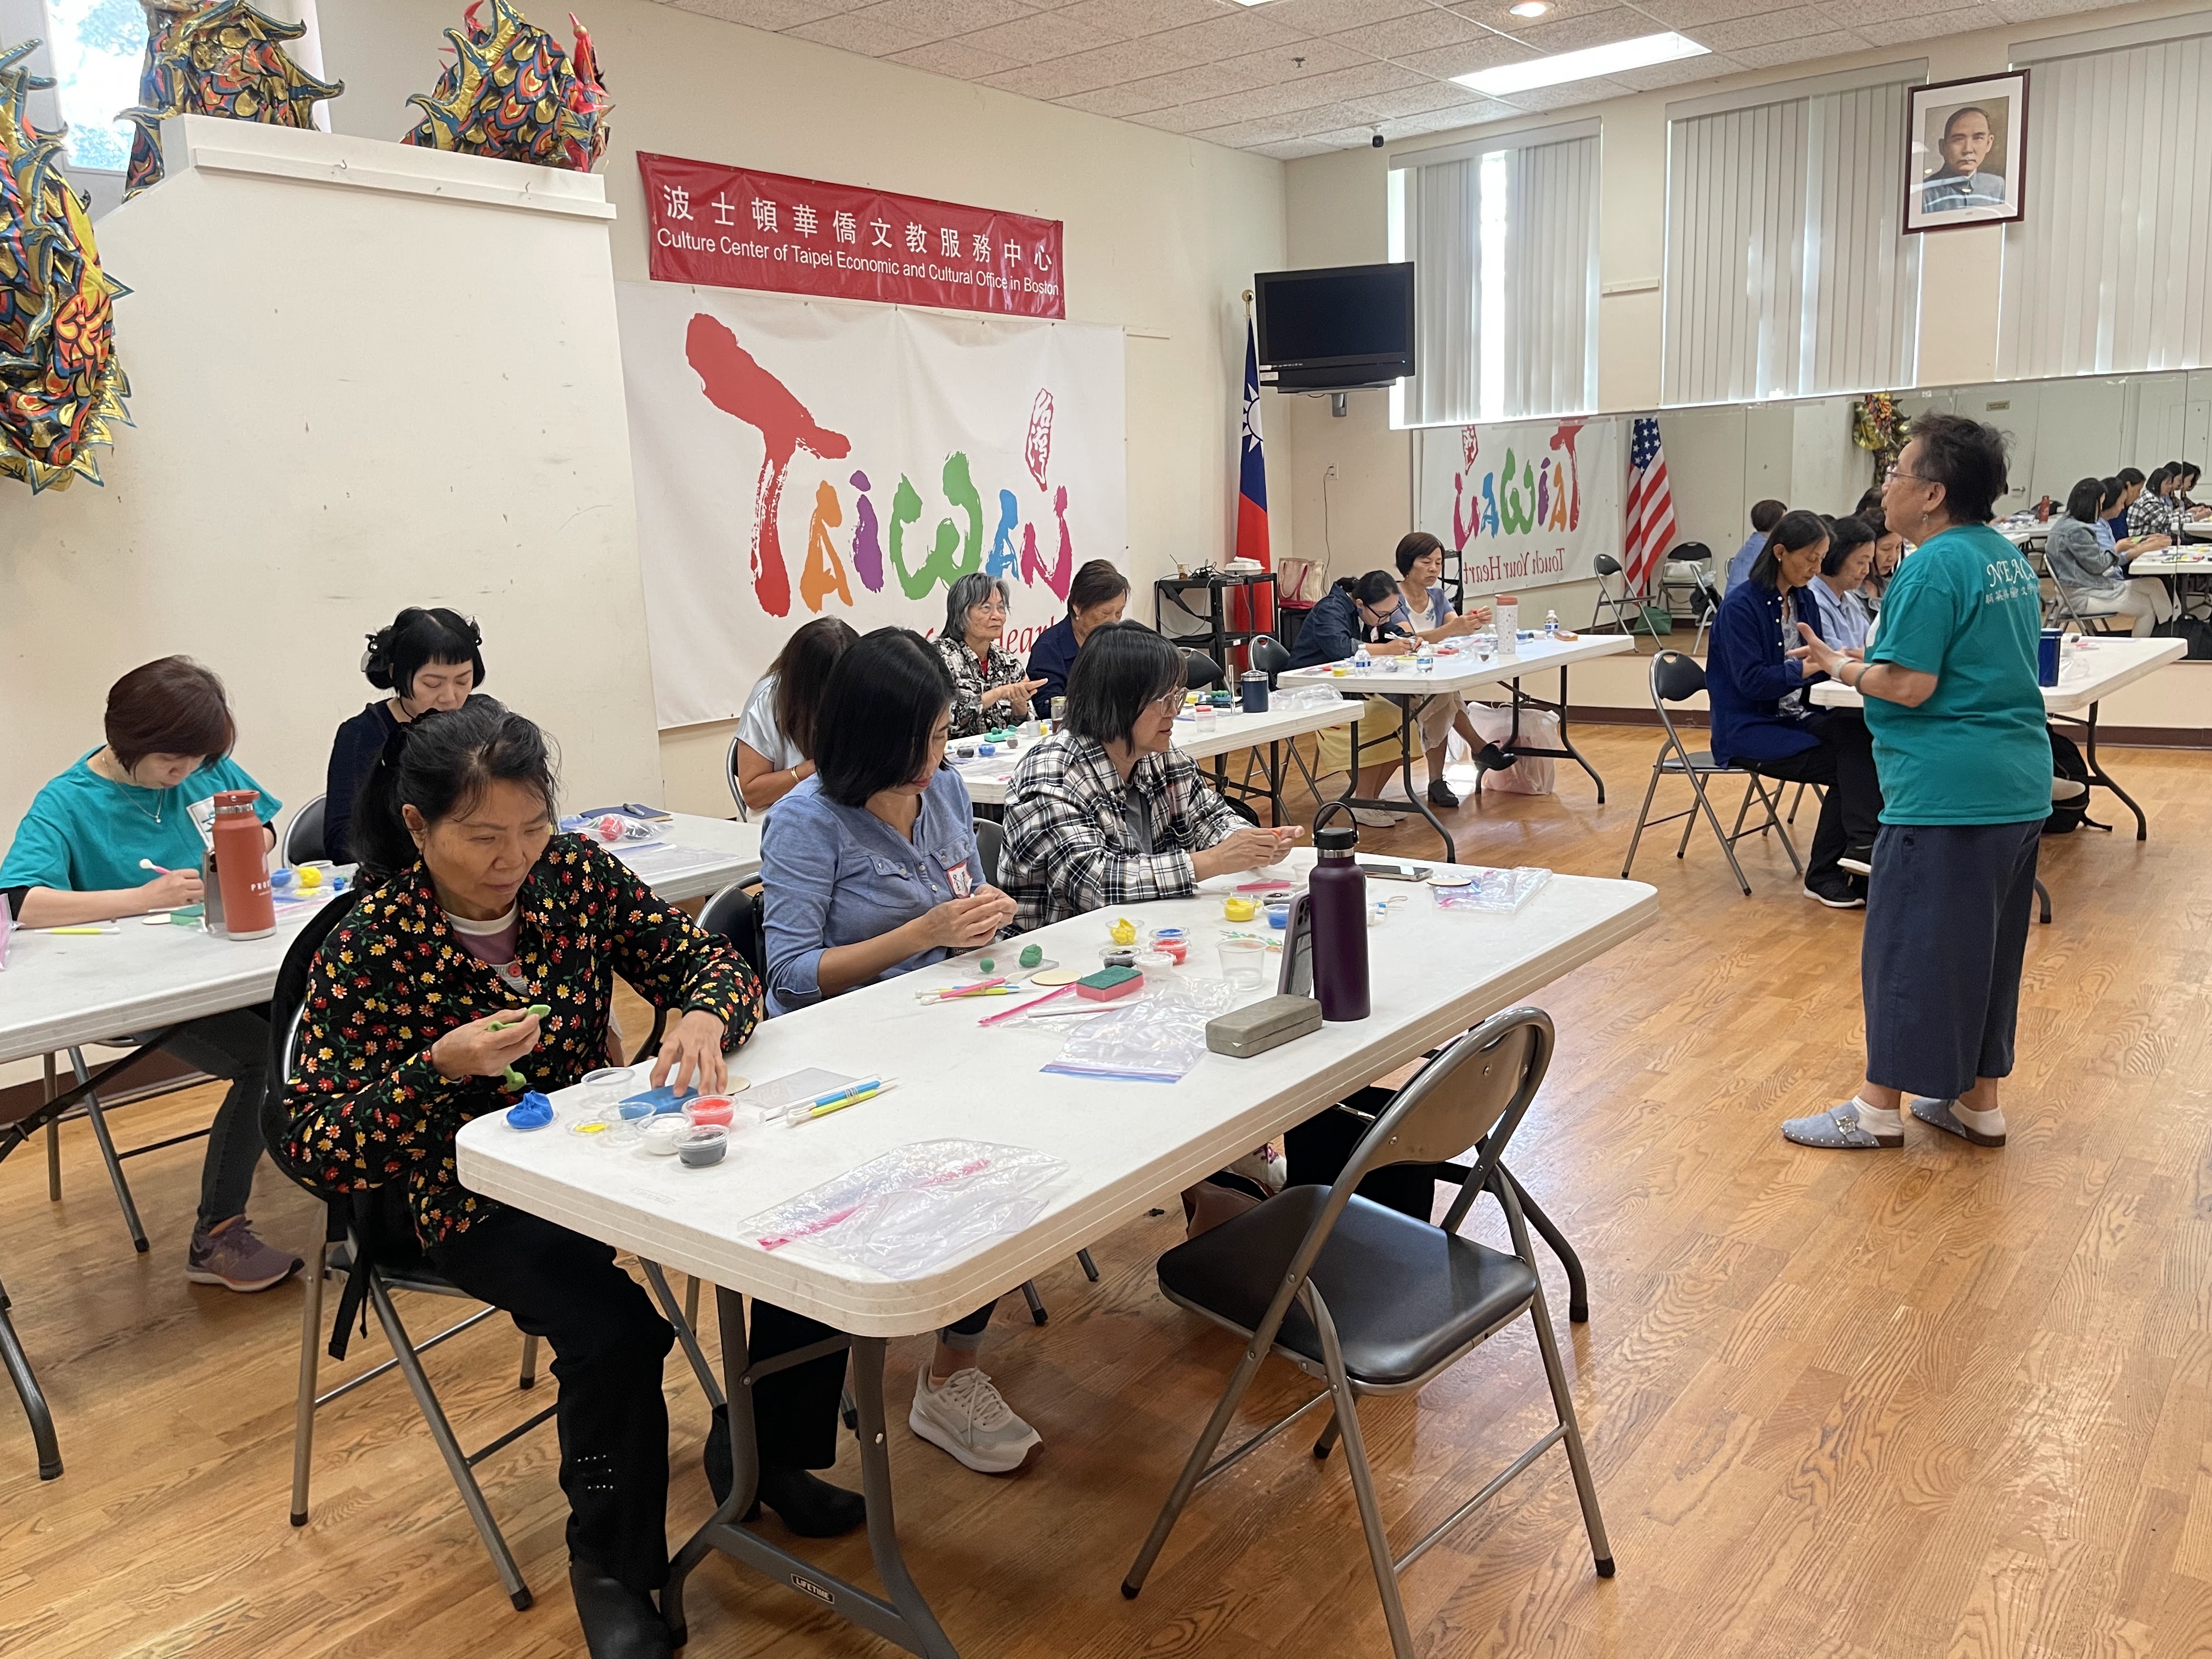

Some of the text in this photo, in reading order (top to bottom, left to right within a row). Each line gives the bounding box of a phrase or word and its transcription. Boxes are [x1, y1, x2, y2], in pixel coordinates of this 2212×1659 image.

[657, 228, 1059, 296] Culture Center of Taipei Economic and Cultural Office in Boston
[663, 184, 1053, 272] 波士頓華僑文教服務中心
